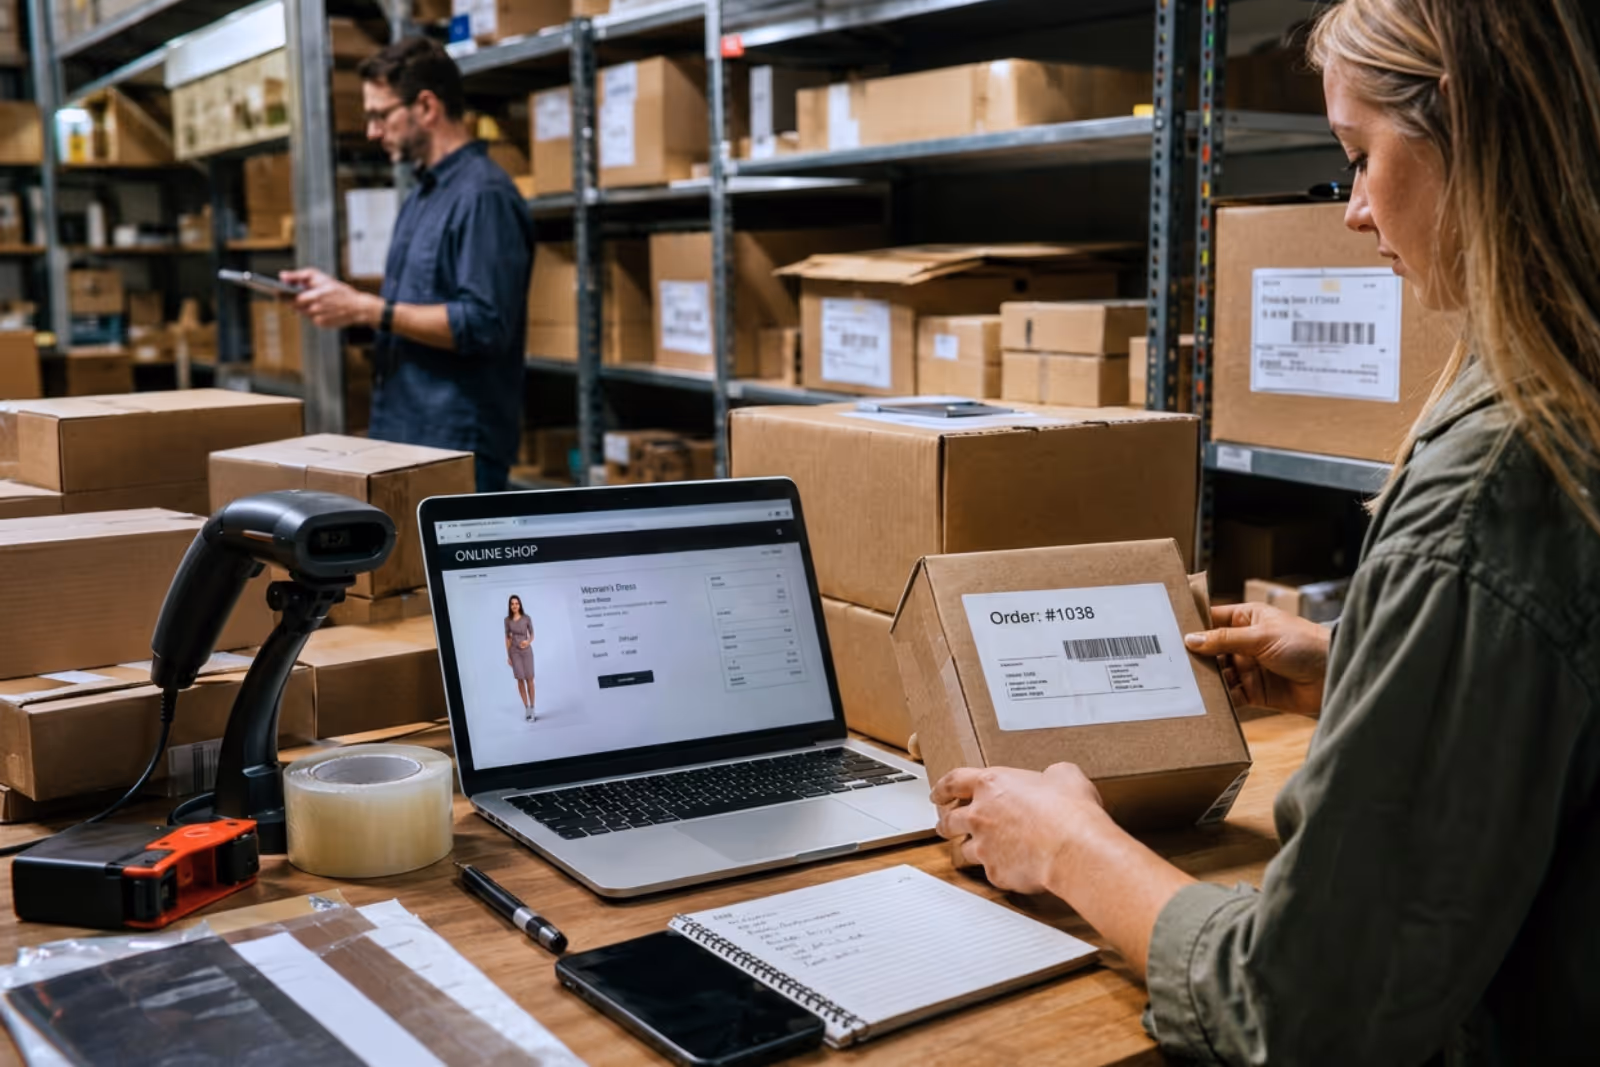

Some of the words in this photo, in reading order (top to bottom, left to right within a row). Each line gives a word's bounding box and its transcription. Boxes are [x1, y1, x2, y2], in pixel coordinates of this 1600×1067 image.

[455, 547, 503, 562] ONLINE
[504, 544, 538, 559] SHOP
[615, 583, 637, 592] Dress
[990, 610, 1041, 625] Order:
[1045, 606, 1095, 622] #1038
